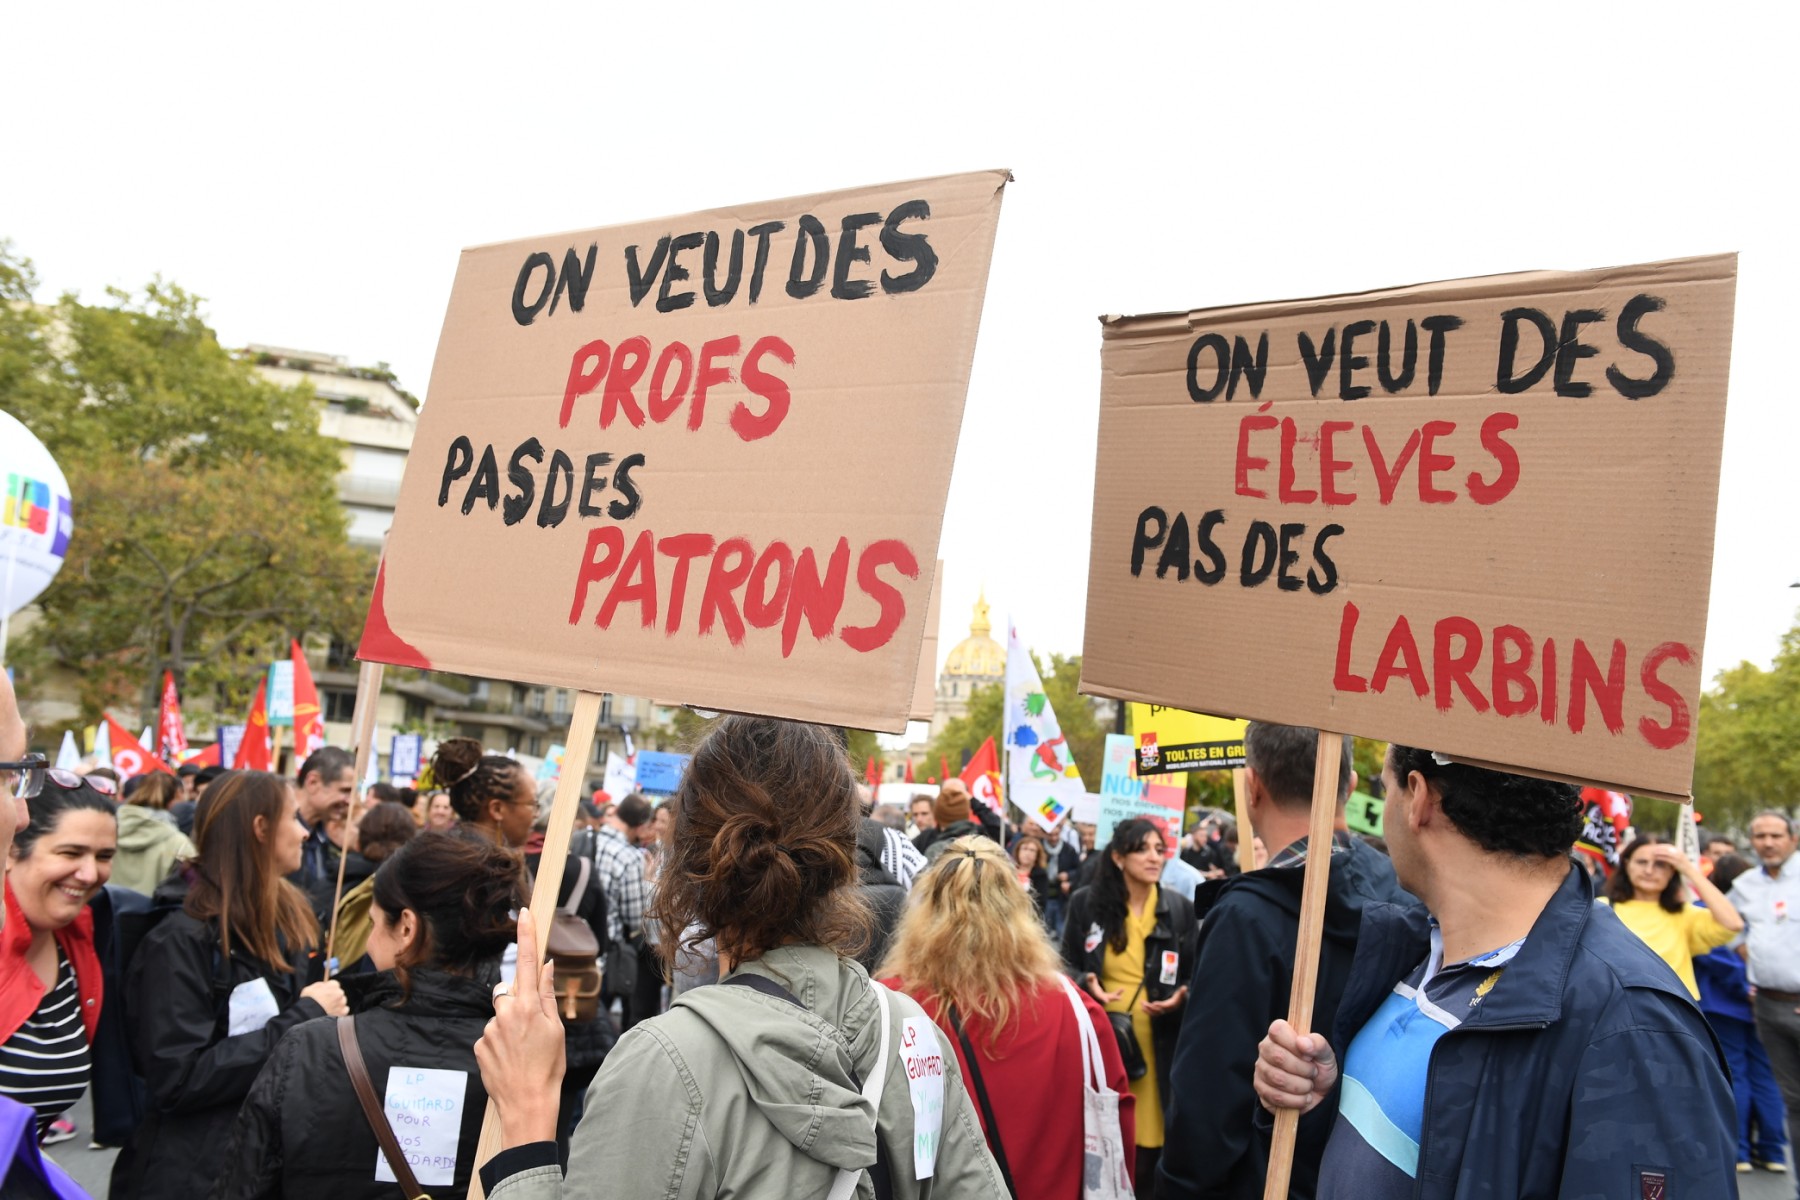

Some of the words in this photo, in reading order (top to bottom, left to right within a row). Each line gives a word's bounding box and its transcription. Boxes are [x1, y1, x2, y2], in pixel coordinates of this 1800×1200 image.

[511, 241, 598, 326] ON
[625, 221, 786, 313] VEUT
[785, 199, 939, 300] DES
[559, 335, 796, 442] PROFS
[1186, 330, 1269, 403] ON
[1297, 315, 1466, 401] VEUT
[1495, 293, 1676, 400] DES
[438, 435, 546, 528] PAS
[536, 449, 646, 529] DES
[1235, 401, 1520, 506] ÉLEVES
[569, 525, 920, 659] PATRONS
[1130, 506, 1228, 586] PAS
[1239, 520, 1345, 595] DES
[1333, 601, 1698, 750] LARBINS
[1105, 773, 1150, 798] NON
[1141, 742, 1158, 757] cgt
[1165, 747, 1207, 762] TOU.TES
[1209, 746, 1224, 758] EN
[406, 1073, 425, 1085] LP
[902, 1026, 916, 1048] LP
[388, 1093, 455, 1112] GUIMARD
